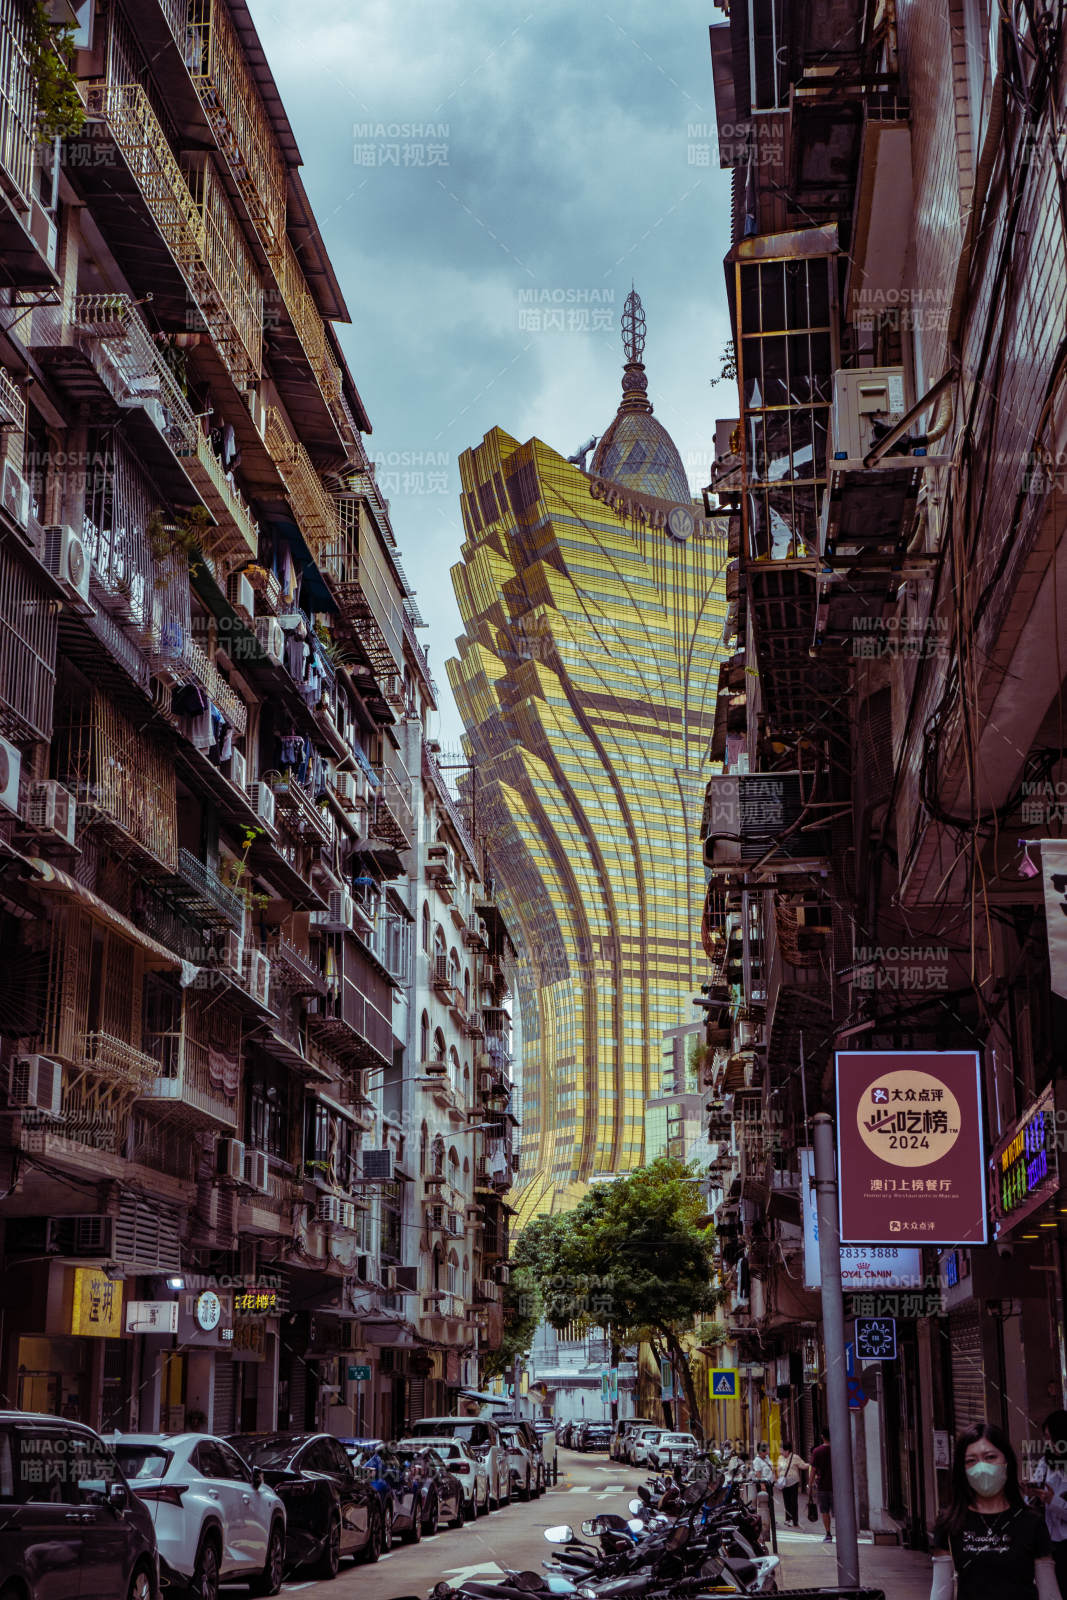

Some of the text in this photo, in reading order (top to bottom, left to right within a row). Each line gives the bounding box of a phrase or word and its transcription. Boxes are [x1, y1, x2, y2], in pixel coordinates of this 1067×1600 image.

[590, 481, 667, 529] GRAND
[891, 1088, 944, 1102] 大众点评
[863, 1109, 948, 1134] 必吃榜
[889, 1136, 930, 1149] 2024
[870, 1179, 953, 1192] 澳门上榜餐厅
[902, 1220, 936, 1231] 大众点评
[840, 1247, 899, 1259] 2835 3888
[840, 1270, 892, 1279] OYAL CANIN
